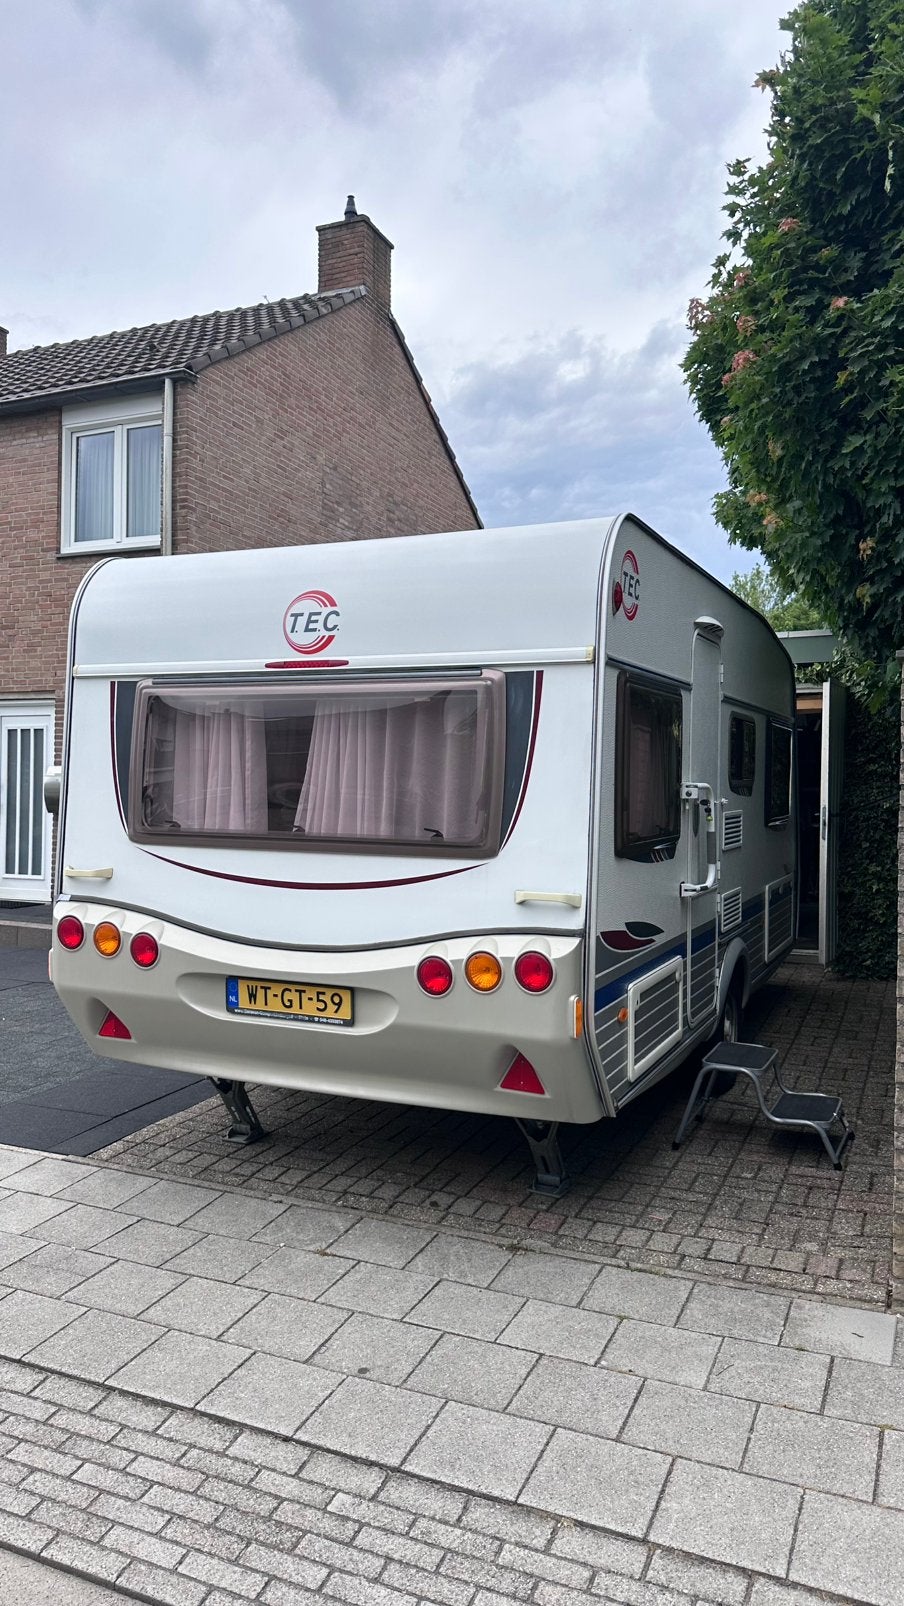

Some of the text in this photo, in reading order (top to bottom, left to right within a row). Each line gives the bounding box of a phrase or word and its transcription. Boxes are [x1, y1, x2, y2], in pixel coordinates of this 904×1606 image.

[290, 610, 340, 633] T.E.C.
[229, 995, 238, 1003] NL
[247, 984, 343, 1013] WT-GT-59
